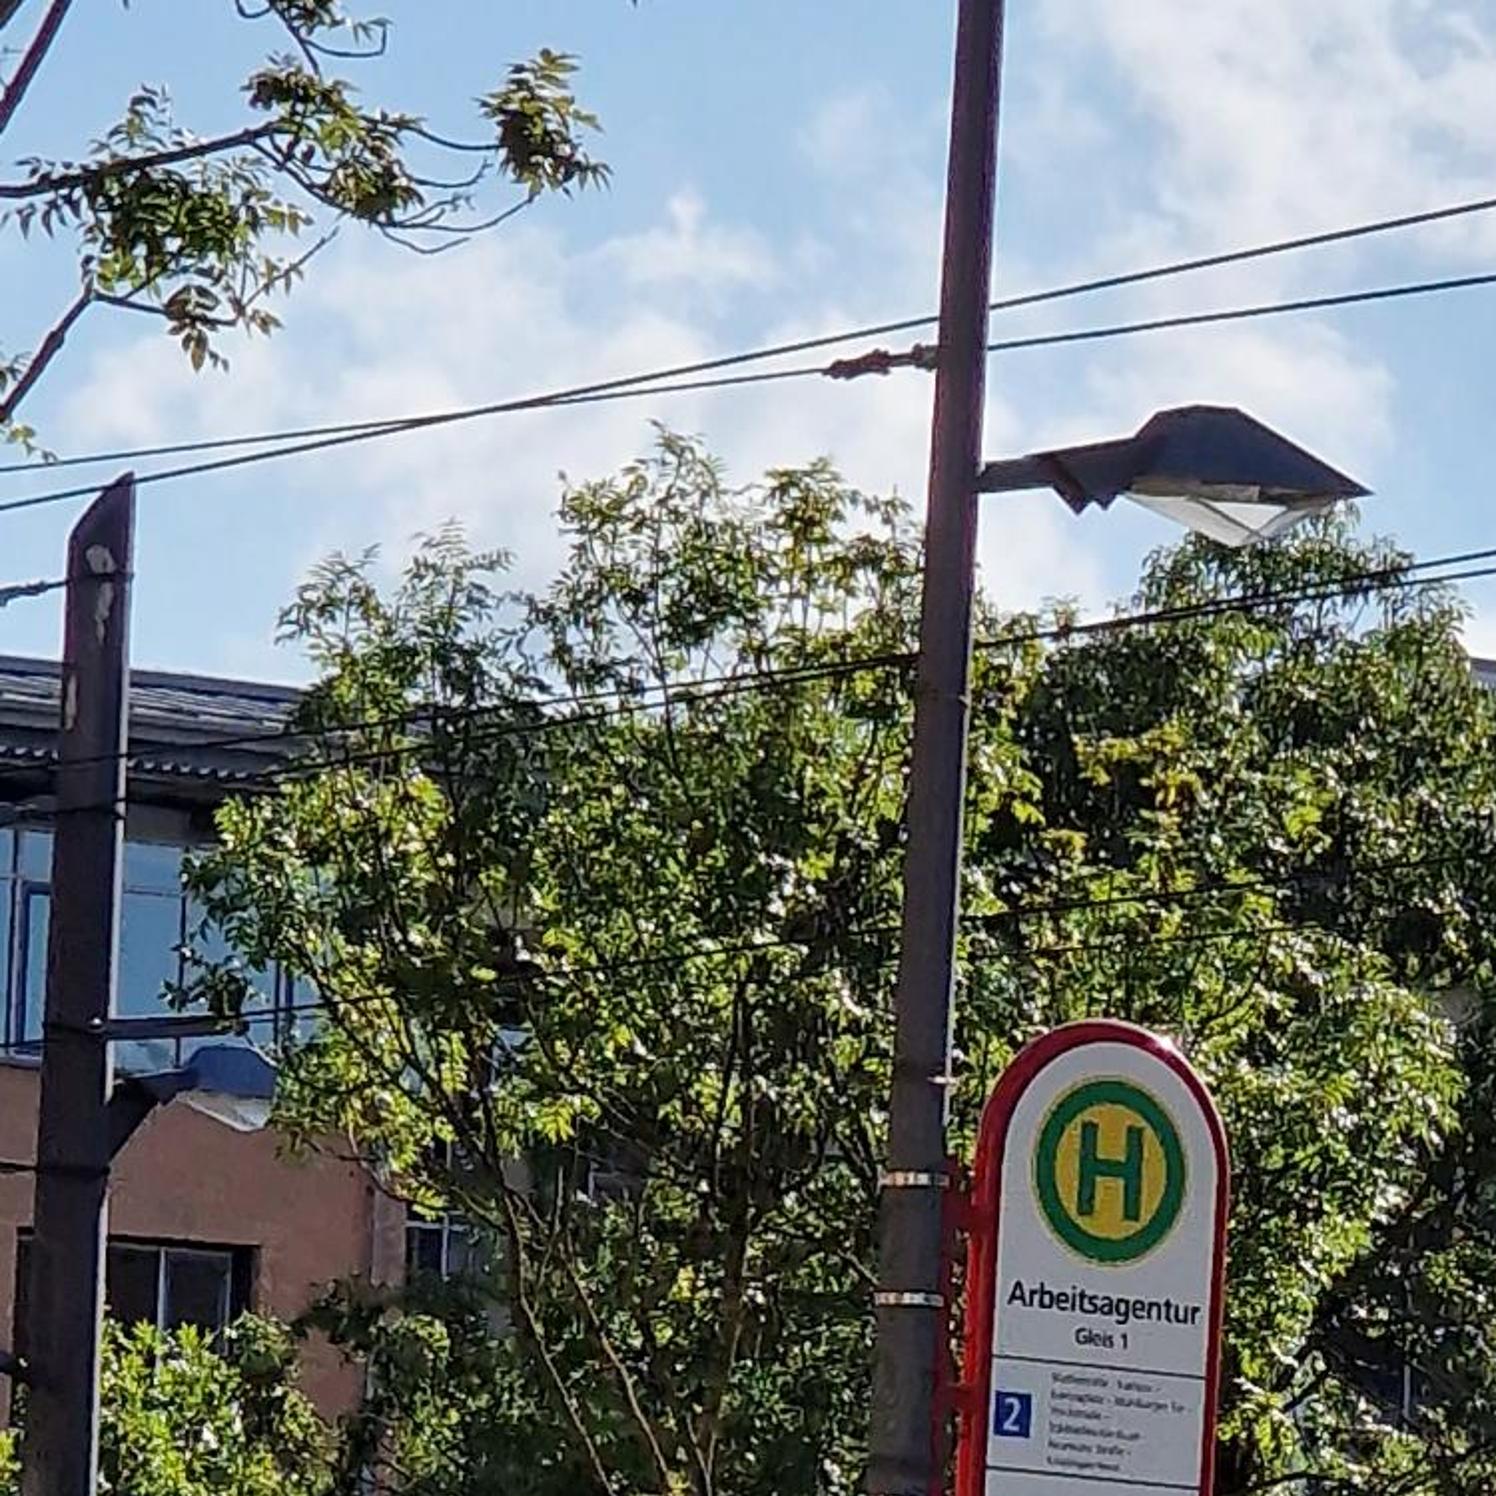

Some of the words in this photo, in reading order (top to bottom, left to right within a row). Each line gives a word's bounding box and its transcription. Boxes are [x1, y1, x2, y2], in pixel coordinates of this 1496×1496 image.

[1077, 1119, 1146, 1223] H
[1007, 1280, 1201, 1326] Arbeitsagentur
[1074, 1327, 1115, 1349] Gleis
[1121, 1332, 1129, 1350] 1
[1002, 1397, 1022, 1432] 2
